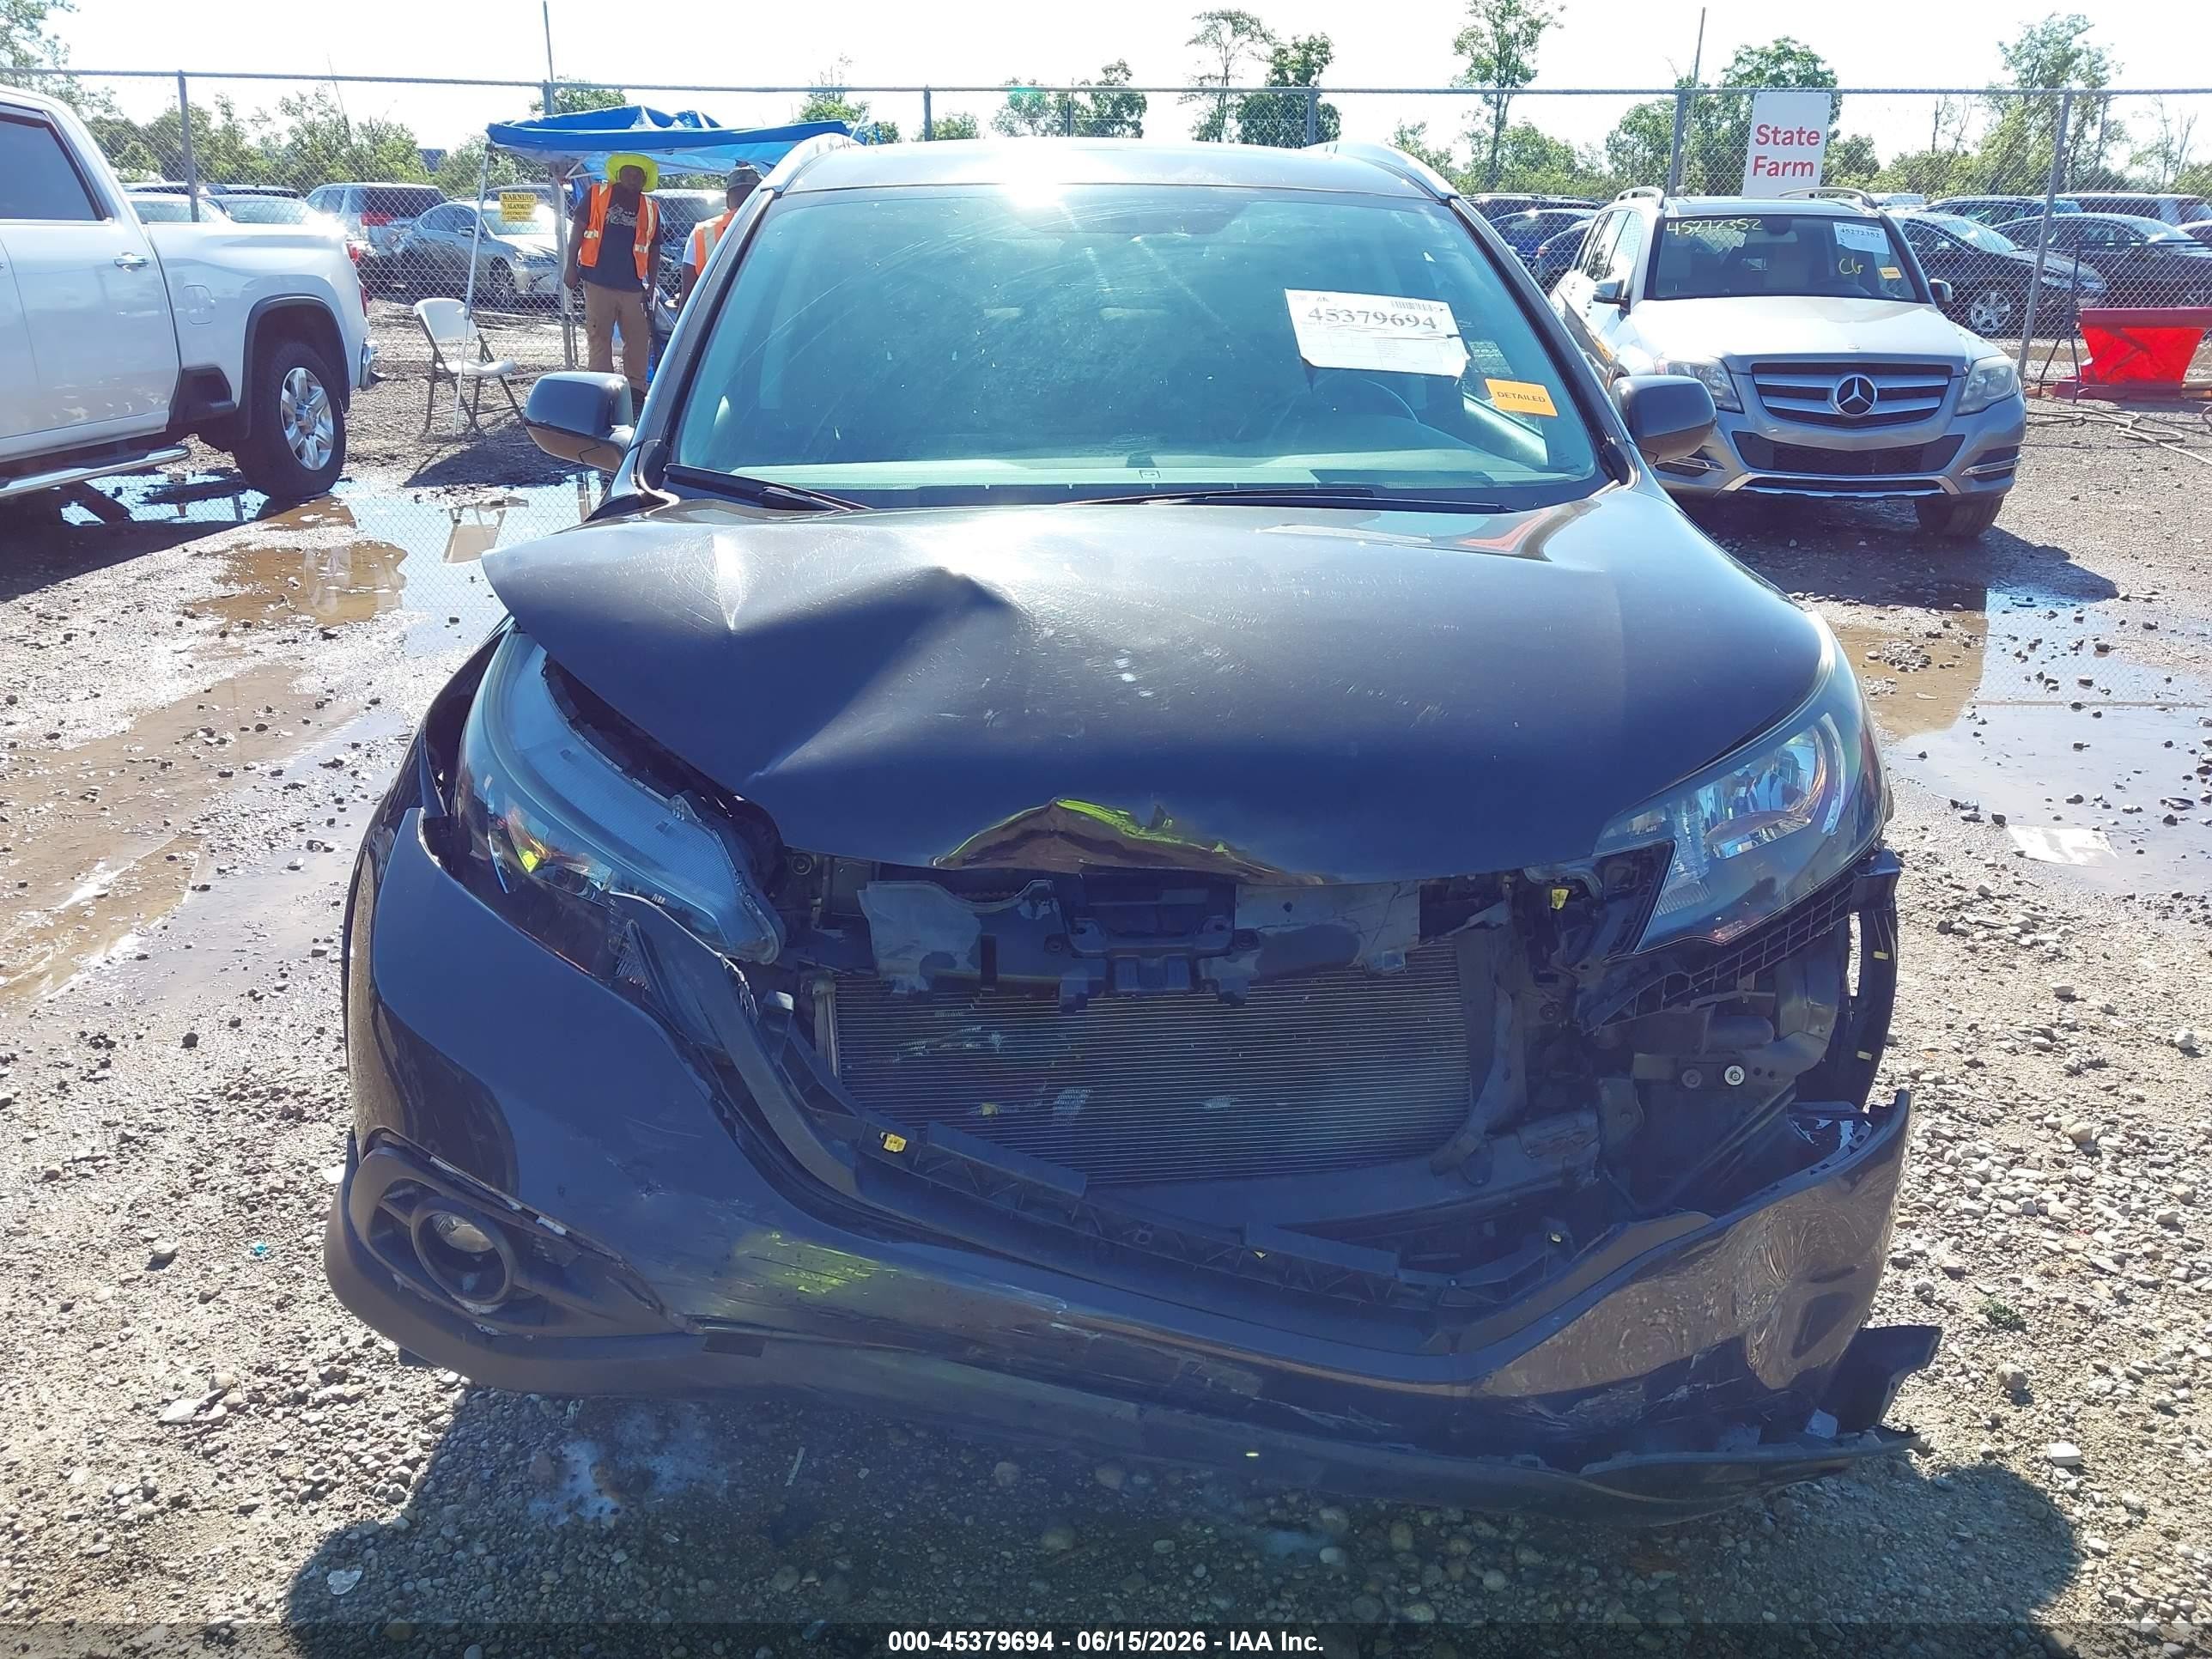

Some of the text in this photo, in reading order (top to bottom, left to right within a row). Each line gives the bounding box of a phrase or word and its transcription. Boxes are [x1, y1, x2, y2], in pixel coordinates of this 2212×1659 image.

[1755, 124, 1820, 146] State
[1752, 155, 1814, 177] Farm
[1667, 218, 1764, 236] 45272352
[1308, 307, 1437, 330] 45379694
[1497, 392, 1546, 403] DETAILED
